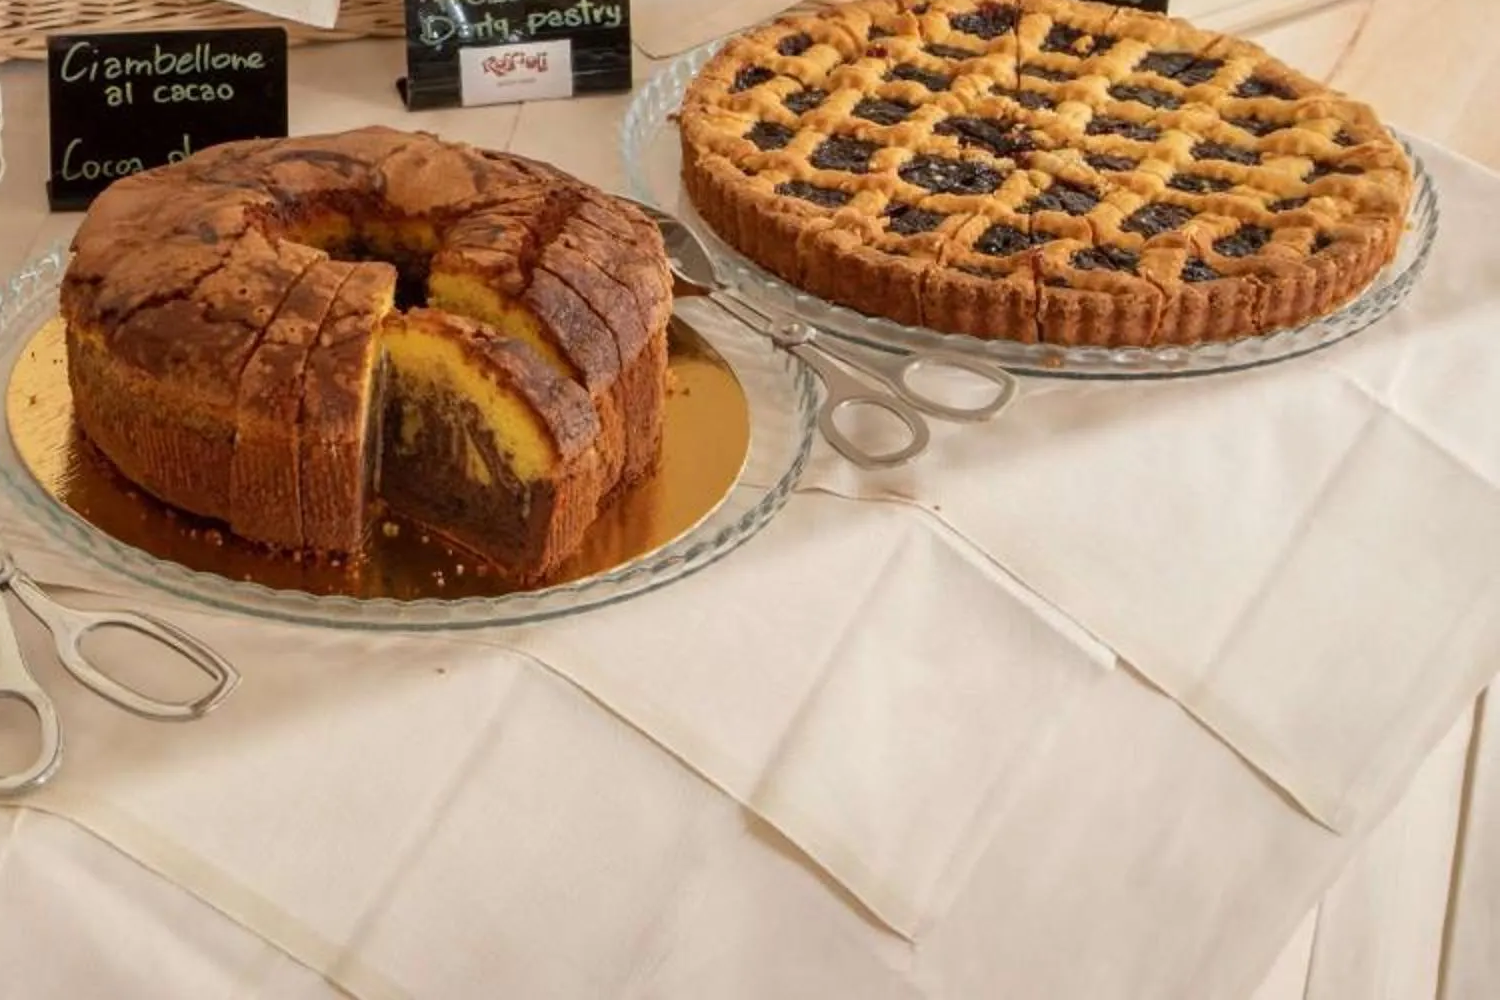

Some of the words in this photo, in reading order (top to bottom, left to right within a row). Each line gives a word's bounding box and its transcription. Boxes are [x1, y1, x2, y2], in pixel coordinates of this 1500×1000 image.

[60, 40, 266, 82] Ciambellone
[103, 81, 134, 107] al
[152, 83, 235, 104] cacao
